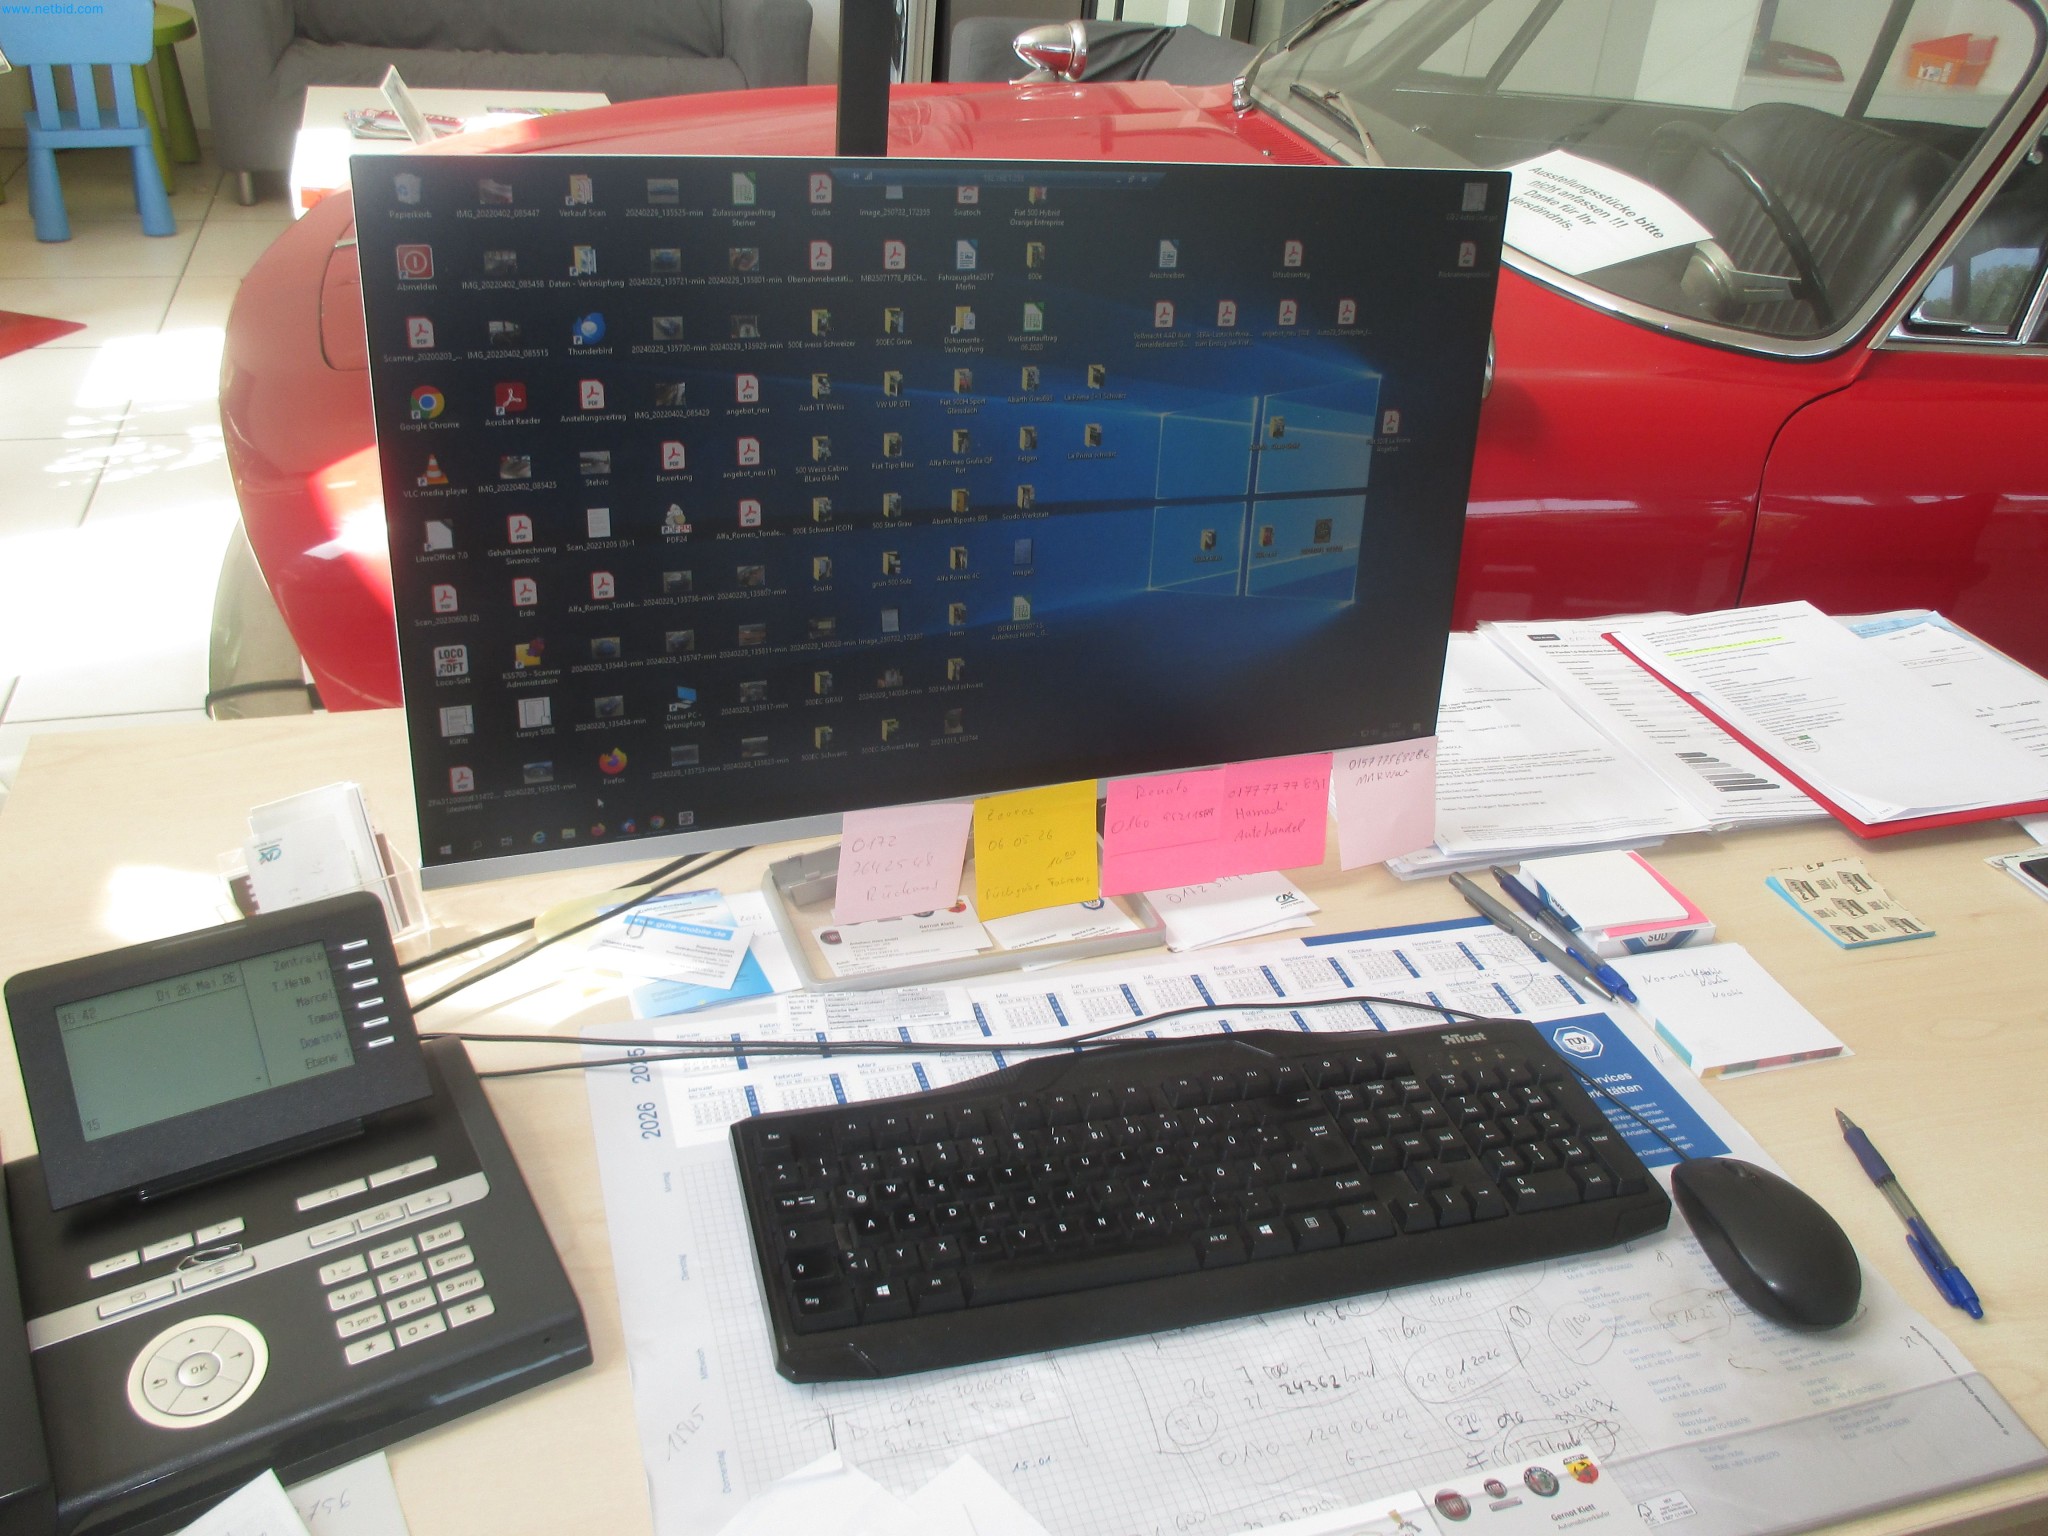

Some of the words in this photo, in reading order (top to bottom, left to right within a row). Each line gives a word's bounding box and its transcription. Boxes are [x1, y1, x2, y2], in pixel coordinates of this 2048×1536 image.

[1527, 179, 1557, 194] nicht
[1557, 189, 1609, 220] anfassen
[1608, 218, 1628, 229] !!!
[1528, 166, 1636, 218] Ausstellungsstücke
[1636, 216, 1664, 240] bitte
[1523, 190, 1558, 206] Danke
[1560, 204, 1577, 216] für
[1576, 213, 1596, 226] Ihr
[389, 209, 431, 218] Papierkorb
[559, 209, 585, 217] Verkauf
[588, 209, 606, 217] Scan
[712, 209, 775, 218] Zulassungsauftrag
[1040, 209, 1060, 217] Hybrid
[1510, 196, 1572, 231] Verständnis.
[732, 219, 756, 227] Steiner
[1010, 219, 1033, 228] Orange
[397, 283, 437, 291] Abmelden
[577, 279, 624, 288] Verknüpfung
[944, 337, 978, 345] Dokumente
[1008, 335, 1057, 343] Werkstattauftrag
[788, 341, 802, 349] 500E
[824, 340, 855, 348] Schweizer
[568, 347, 613, 355] Thunderbird
[726, 407, 770, 416] angebot_neu
[826, 403, 844, 411] Weiss
[515, 417, 540, 425] Reader
[560, 413, 626, 423] Anstellungsvertrag
[400, 423, 427, 431] Google
[430, 421, 460, 429] Chrome
[656, 474, 692, 482] Bewertung
[723, 470, 766, 479] angebot_neu
[420, 489, 444, 497] media
[447, 487, 468, 497] player
[488, 545, 556, 557] Gehaltsabrechnung
[416, 553, 455, 563] LibreOffice
[439, 648, 463, 659] LOCO
[440, 663, 463, 674] SOFT
[436, 677, 470, 687] Loco-Soft
[507, 678, 558, 688] Administration
[516, 728, 539, 737] Leasys
[603, 777, 625, 785] Firefox
[1412, 940, 1442, 948] November
[1281, 954, 1315, 963] September
[1453, 1032, 1486, 1044] Trust
[1565, 1037, 1587, 1045] TÜV
[639, 1102, 660, 1139] 2026
[847, 1189, 855, 1199] Q
[886, 1184, 896, 1193] W
[928, 1179, 935, 1187] E
[967, 1174, 975, 1182] R
[867, 1219, 875, 1228] A
[908, 1213, 915, 1222] S
[949, 1208, 956, 1216] D
[989, 1202, 995, 1210] F
[427, 1234, 435, 1242] 3
[439, 1229, 452, 1239] def
[938, 1243, 946, 1251] X
[1019, 1230, 1026, 1238] V
[381, 1251, 389, 1259] 2
[393, 1246, 409, 1256] abc
[436, 1258, 445, 1266] 6
[448, 1252, 466, 1263] mno
[446, 1284, 455, 1292] 9
[337, 1293, 346, 1301] 4
[349, 1289, 363, 1300] ghi
[399, 1301, 407, 1309] 8
[346, 1320, 354, 1328] 7
[357, 1313, 378, 1326] pqrs
[408, 1327, 417, 1336] 0
[191, 1361, 208, 1375] OK
[1551, 1508, 1574, 1521] Gernot
[1576, 1504, 1595, 1516] Klett
